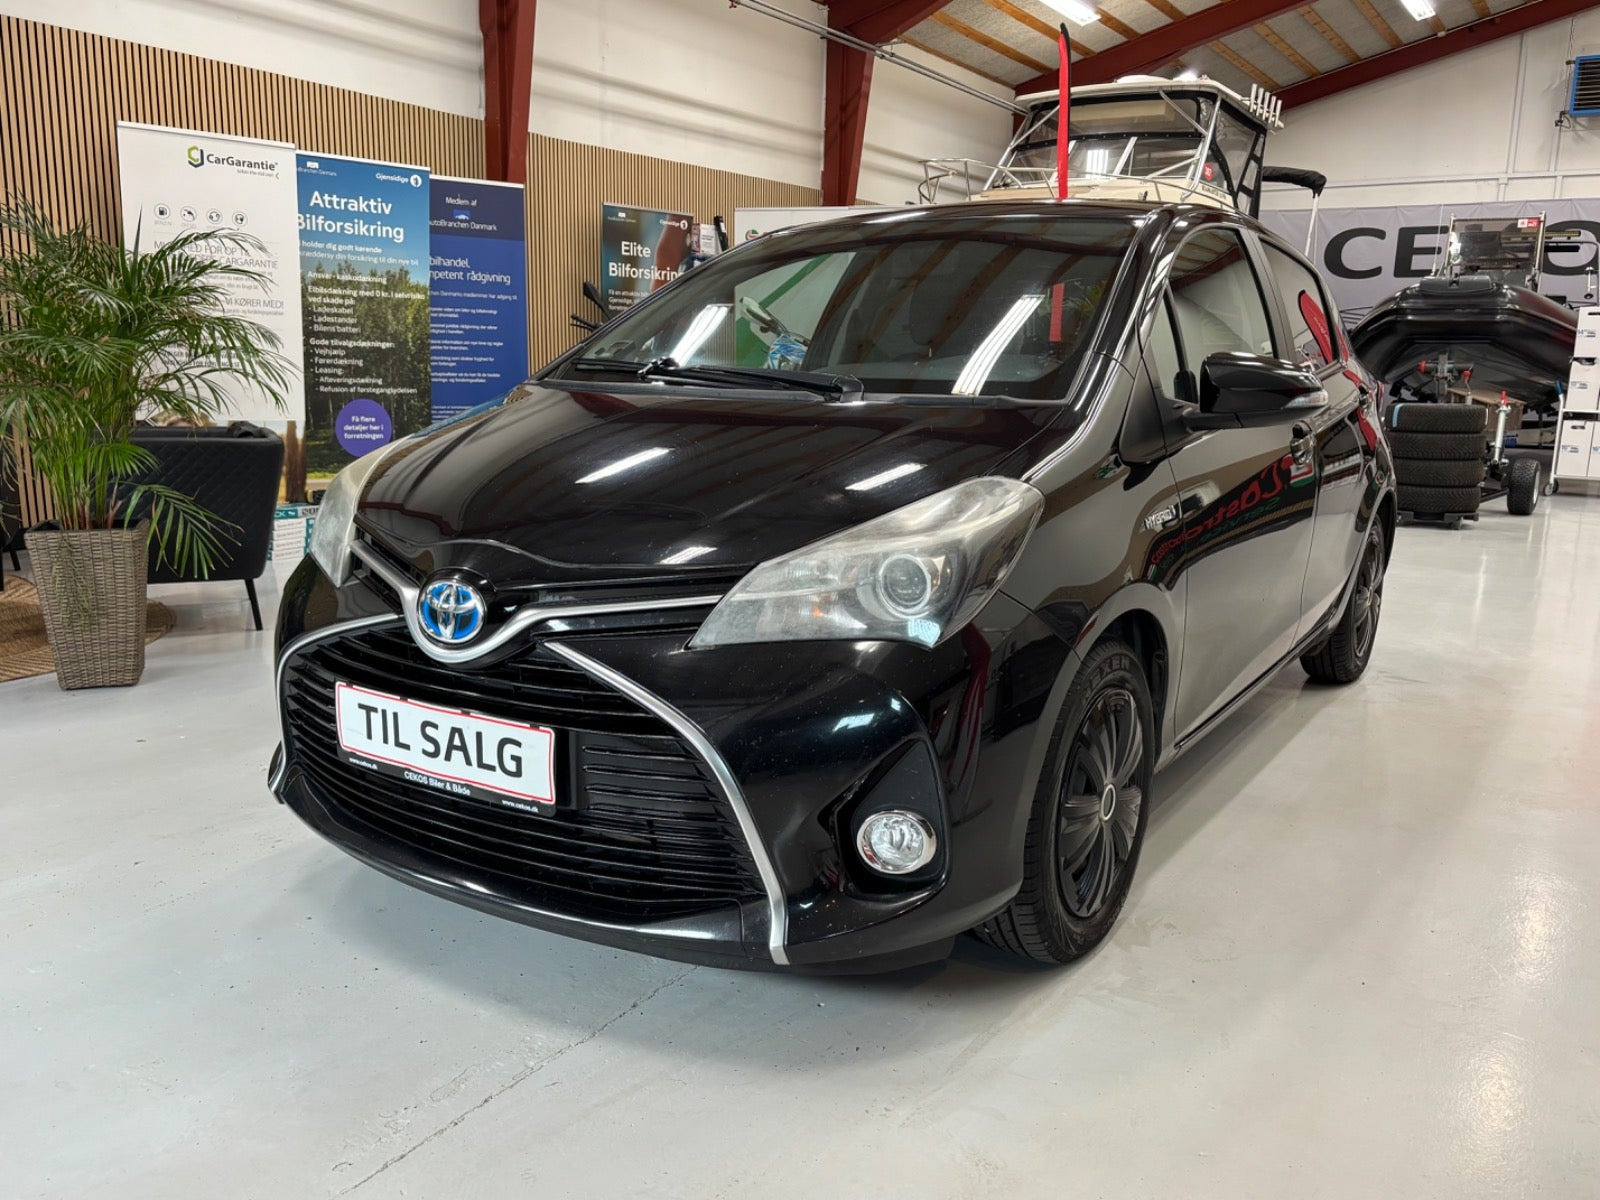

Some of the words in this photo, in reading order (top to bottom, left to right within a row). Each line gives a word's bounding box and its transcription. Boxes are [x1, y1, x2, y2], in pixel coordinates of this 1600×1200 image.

[310, 190, 392, 215] Attraktiv
[445, 196, 469, 206] Medlem
[470, 222, 497, 231] Danmark
[302, 240, 324, 248] holder
[326, 242, 336, 251] dig
[338, 244, 353, 252] godt
[621, 241, 651, 258] Elite
[467, 270, 511, 285] rådgivning
[358, 702, 410, 751] TIL
[420, 720, 522, 778] SALG
[404, 770, 428, 785] CEKOS
[429, 777, 444, 790] Biler
[445, 781, 451, 790] &
[453, 782, 471, 796] Både
